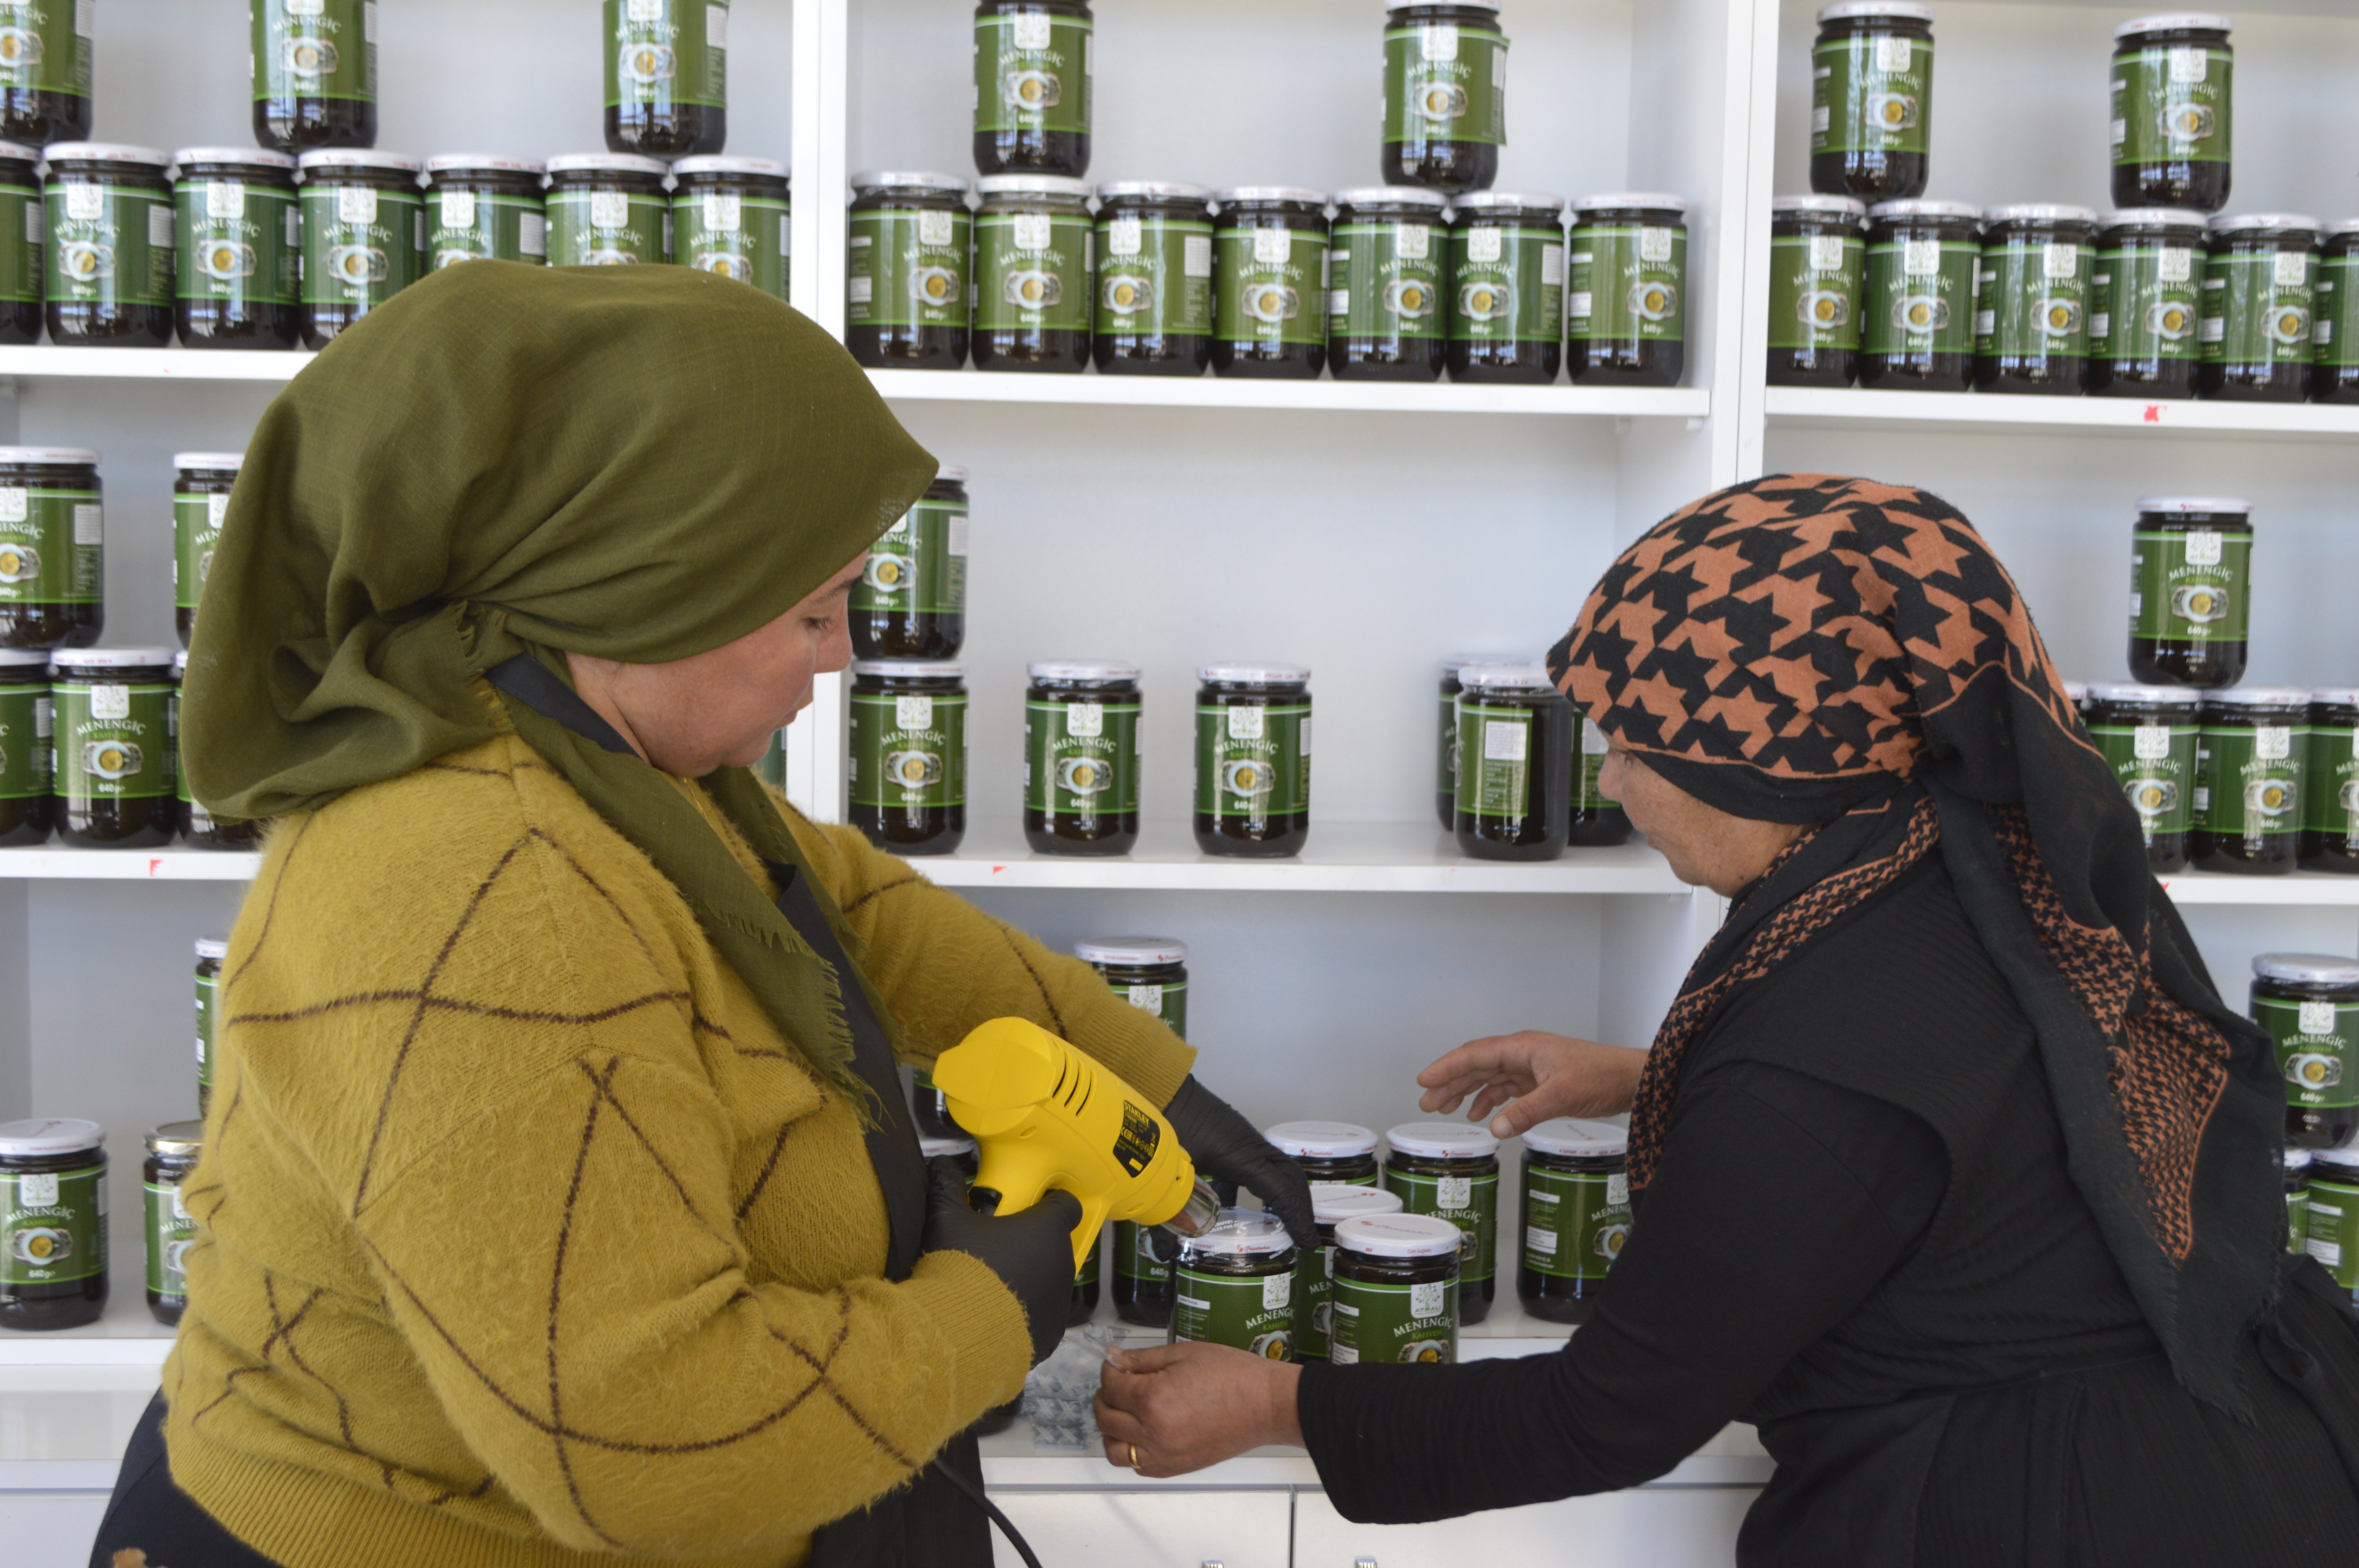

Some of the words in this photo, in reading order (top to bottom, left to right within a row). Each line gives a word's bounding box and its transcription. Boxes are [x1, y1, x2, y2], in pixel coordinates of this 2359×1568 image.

[76, 719, 146, 736] MENENGİÇ
[882, 730, 946, 746] MENENGİÇ
[1052, 736, 1117, 753] MENENGİÇ
[1215, 739, 1279, 755] MENENGİÇ
[1125, 1102, 1150, 1126] STANLEY
[7, 1205, 76, 1223] MENENGİÇ
[1394, 1316, 1453, 1338] MENENGİÇ
